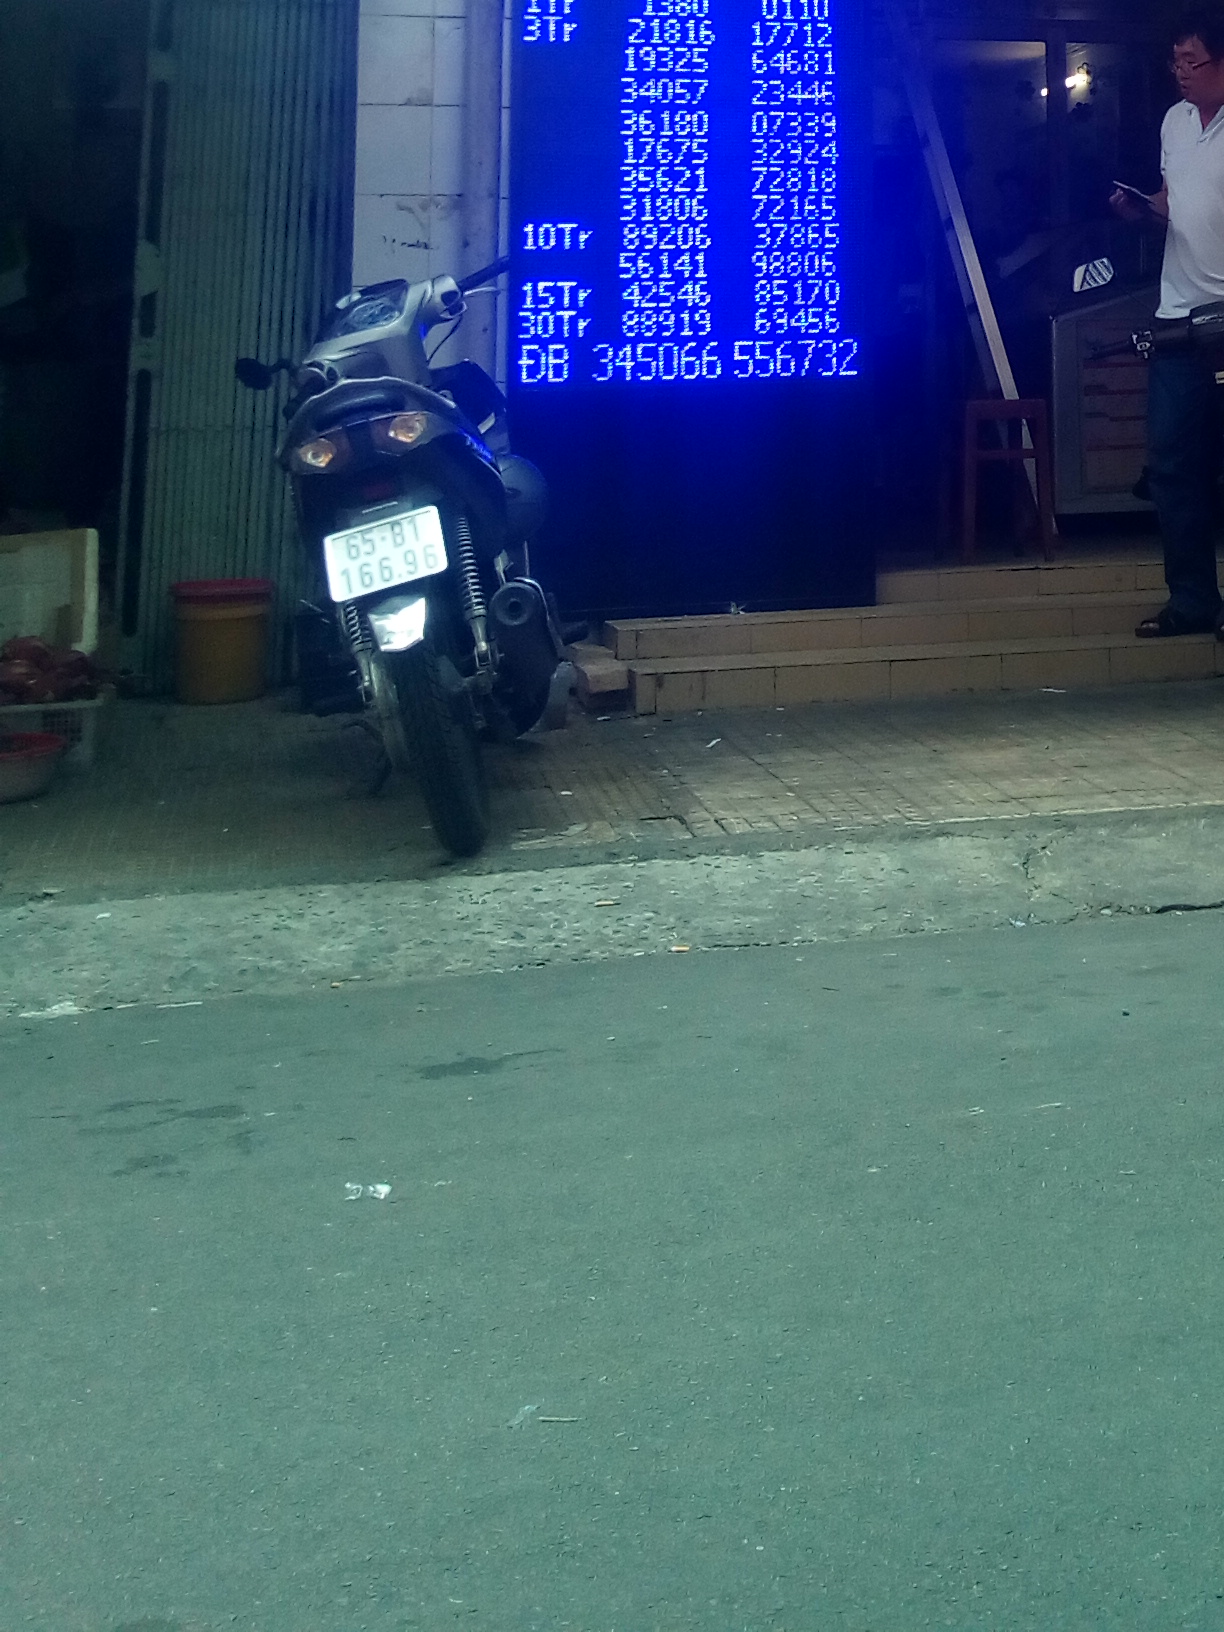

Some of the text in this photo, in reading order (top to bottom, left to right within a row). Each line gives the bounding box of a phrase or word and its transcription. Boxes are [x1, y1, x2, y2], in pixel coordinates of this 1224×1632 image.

[524, 15, 832, 47] 3Tr 21816 17712
[625, 47, 835, 74] 19325 64681
[621, 78, 708, 104] 34057
[620, 110, 836, 137] 36180 07339
[624, 138, 839, 164] 17675 32924
[620, 167, 836, 192] 35621 72818
[620, 195, 836, 221] 31806 72165
[524, 223, 839, 249] 10Tr 89206 37865
[619, 251, 835, 278] 56141 98806
[522, 282, 592, 308] 15Tr
[755, 280, 840, 305] 85170
[518, 308, 839, 338] 30Tr 88919 69456
[518, 339, 857, 382] ĐB 345066 556732
[341, 544, 439, 594] 166.96
